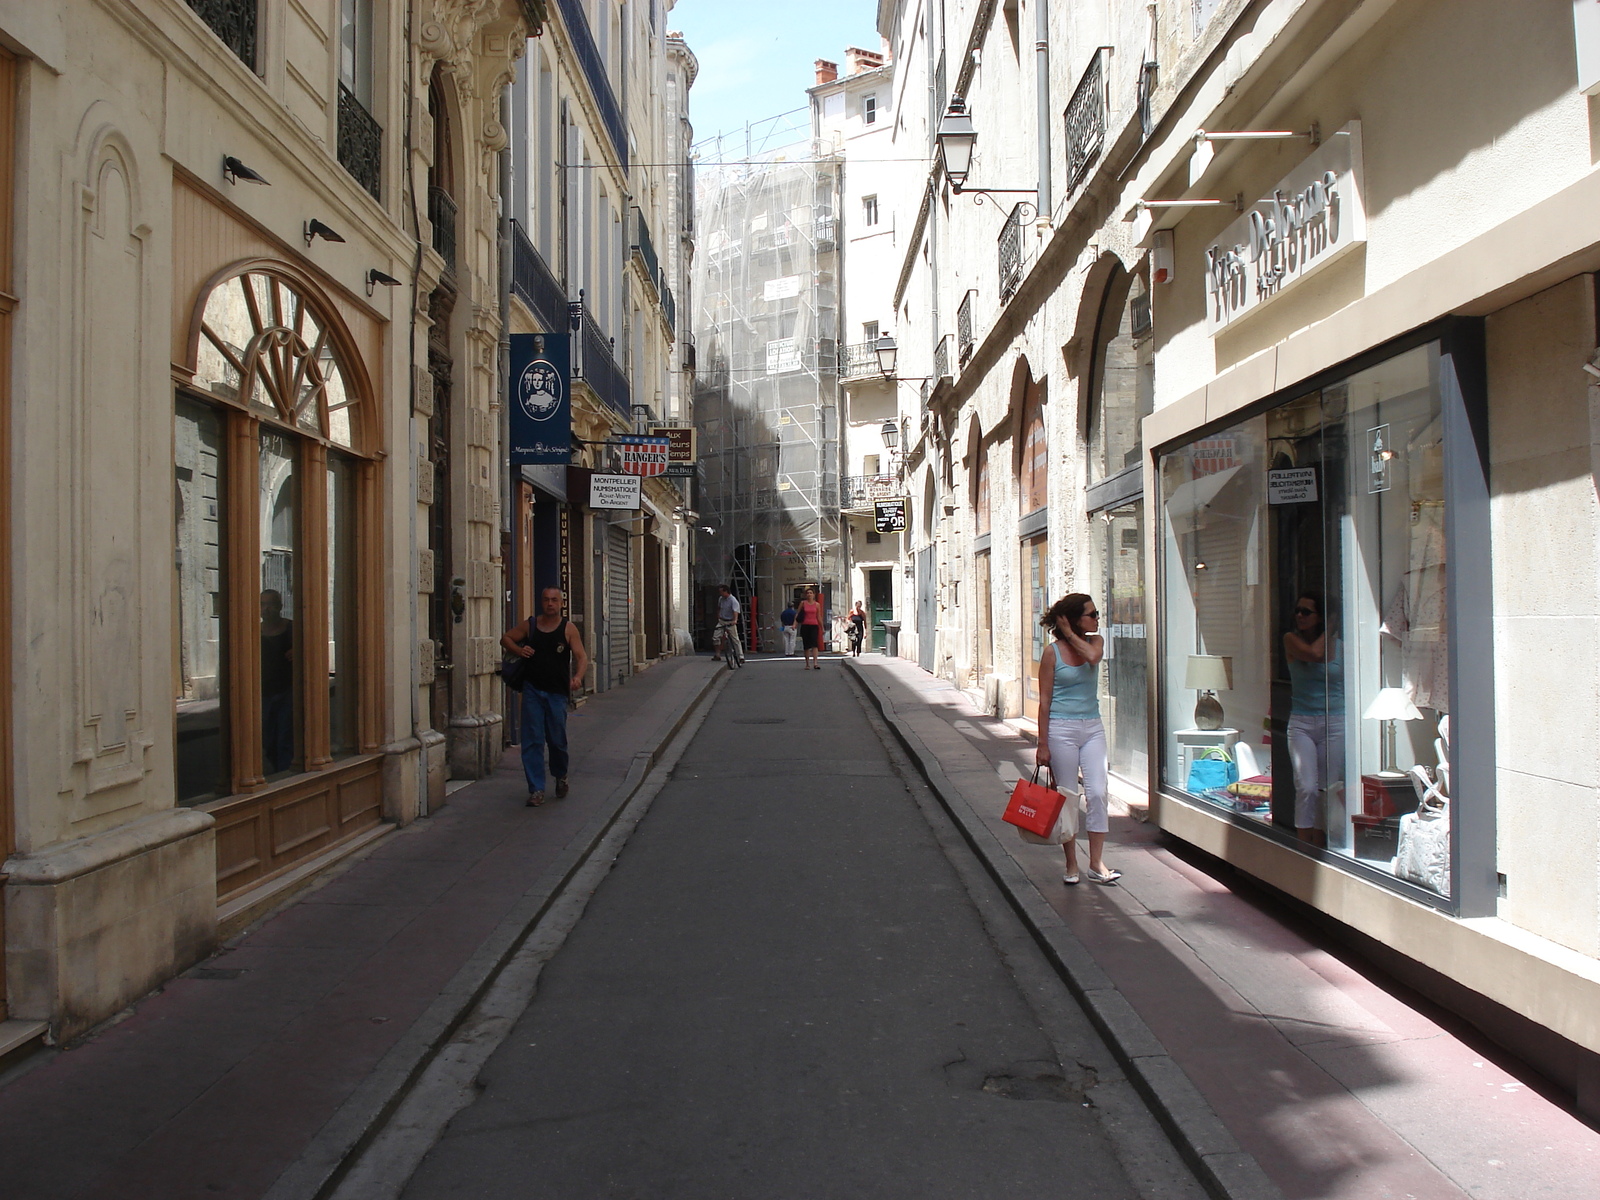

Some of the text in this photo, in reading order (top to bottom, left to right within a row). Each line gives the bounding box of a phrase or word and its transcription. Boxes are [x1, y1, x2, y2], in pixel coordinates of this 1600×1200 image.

[1205, 171, 1339, 294] Yves Delorme
[624, 452, 666, 463] RANGER'S
[593, 477, 637, 485] MONTPELLIER
[593, 486, 638, 494] NUMISMATIQUE
[890, 516, 905, 526] OR
